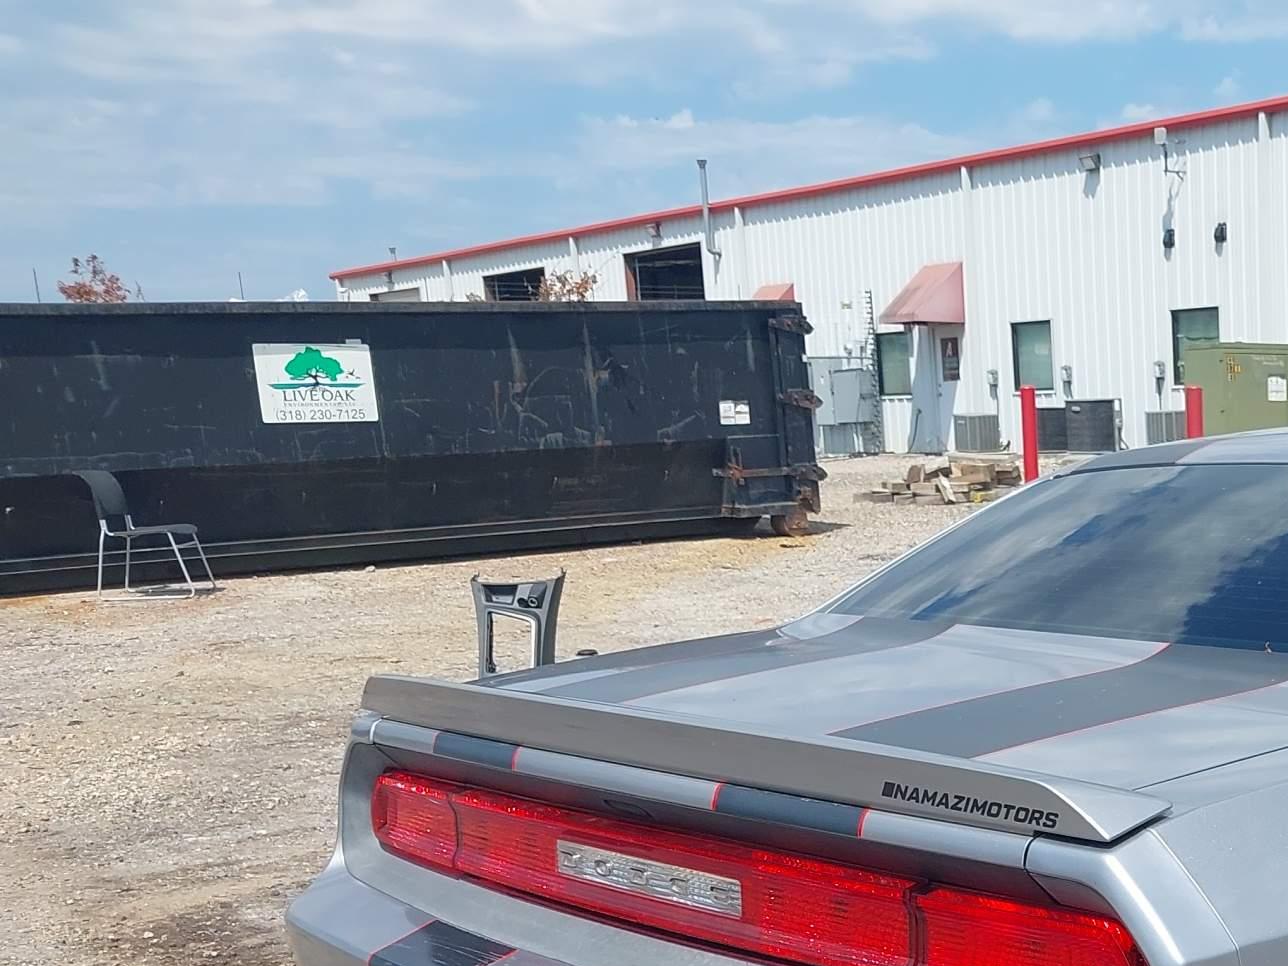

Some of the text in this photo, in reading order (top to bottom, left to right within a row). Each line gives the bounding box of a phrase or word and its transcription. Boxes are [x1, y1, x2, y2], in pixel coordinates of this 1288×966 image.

[282, 388, 356, 402] LIVE OAK
[275, 408, 366, 421] (318) 230-7125
[893, 783, 1060, 829] NAMAZIMOTORS
